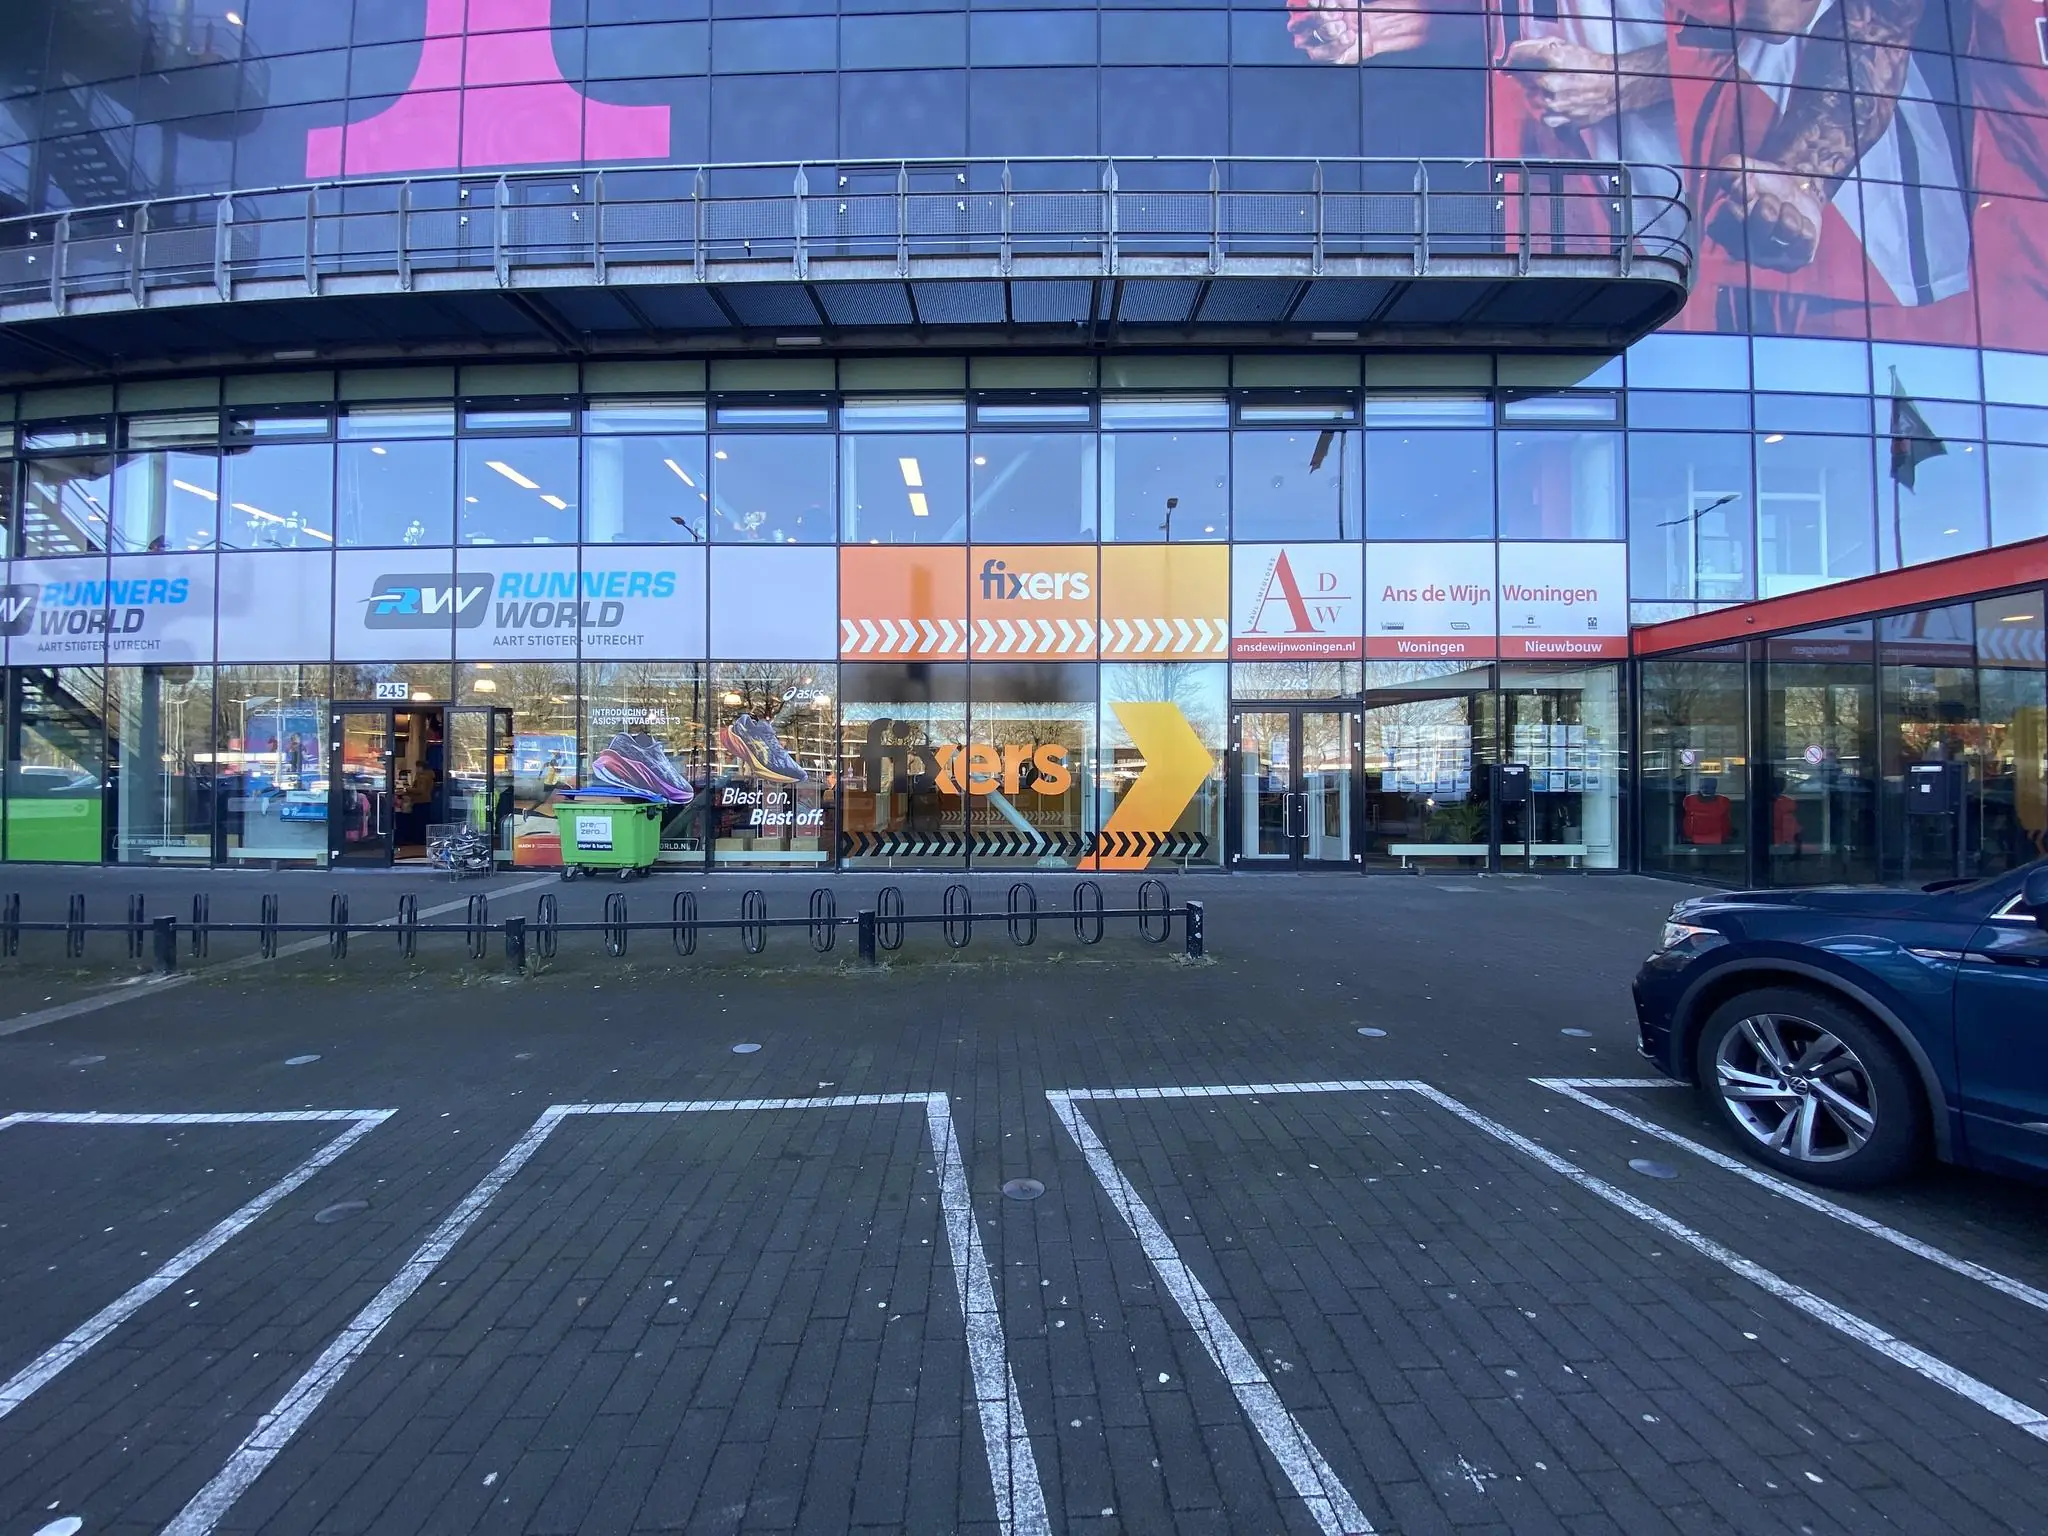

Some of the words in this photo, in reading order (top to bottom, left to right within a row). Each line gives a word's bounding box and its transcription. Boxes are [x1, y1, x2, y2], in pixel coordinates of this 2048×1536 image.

[497, 571, 677, 598] RUNNERS
[979, 559, 1091, 600] fixers
[1319, 572, 1338, 592] D
[41, 578, 190, 607] RUNNERS
[372, 586, 485, 615] RW
[1382, 585, 1417, 602] Ans
[1422, 584, 1445, 602] de
[1449, 585, 1491, 606] Wijn
[1502, 584, 1598, 606] Woningen
[40, 608, 145, 636] WORLD
[496, 601, 625, 629] WORLD
[1315, 606, 1342, 624] W
[37, 642, 63, 652] AART
[64, 641, 106, 651] STIGTER
[113, 640, 161, 650] UTRECHT
[493, 635, 525, 647] AART
[527, 635, 578, 646] STIGTER
[587, 634, 644, 646] UTRECHT
[1237, 641, 1356, 654] ansdewijnwoningen.nl
[1397, 641, 1465, 655] Woningen
[1525, 641, 1603, 653] Nieuwbouw
[377, 684, 406, 699] 245
[1282, 679, 1308, 690] 243
[592, 708, 647, 717] INTRODUCING
[649, 708, 665, 717] THE
[860, 717, 1072, 796] fixers
[722, 787, 763, 805] Blast
[766, 790, 791, 805] on.
[750, 808, 795, 825] Blast
[796, 808, 824, 826] off.
